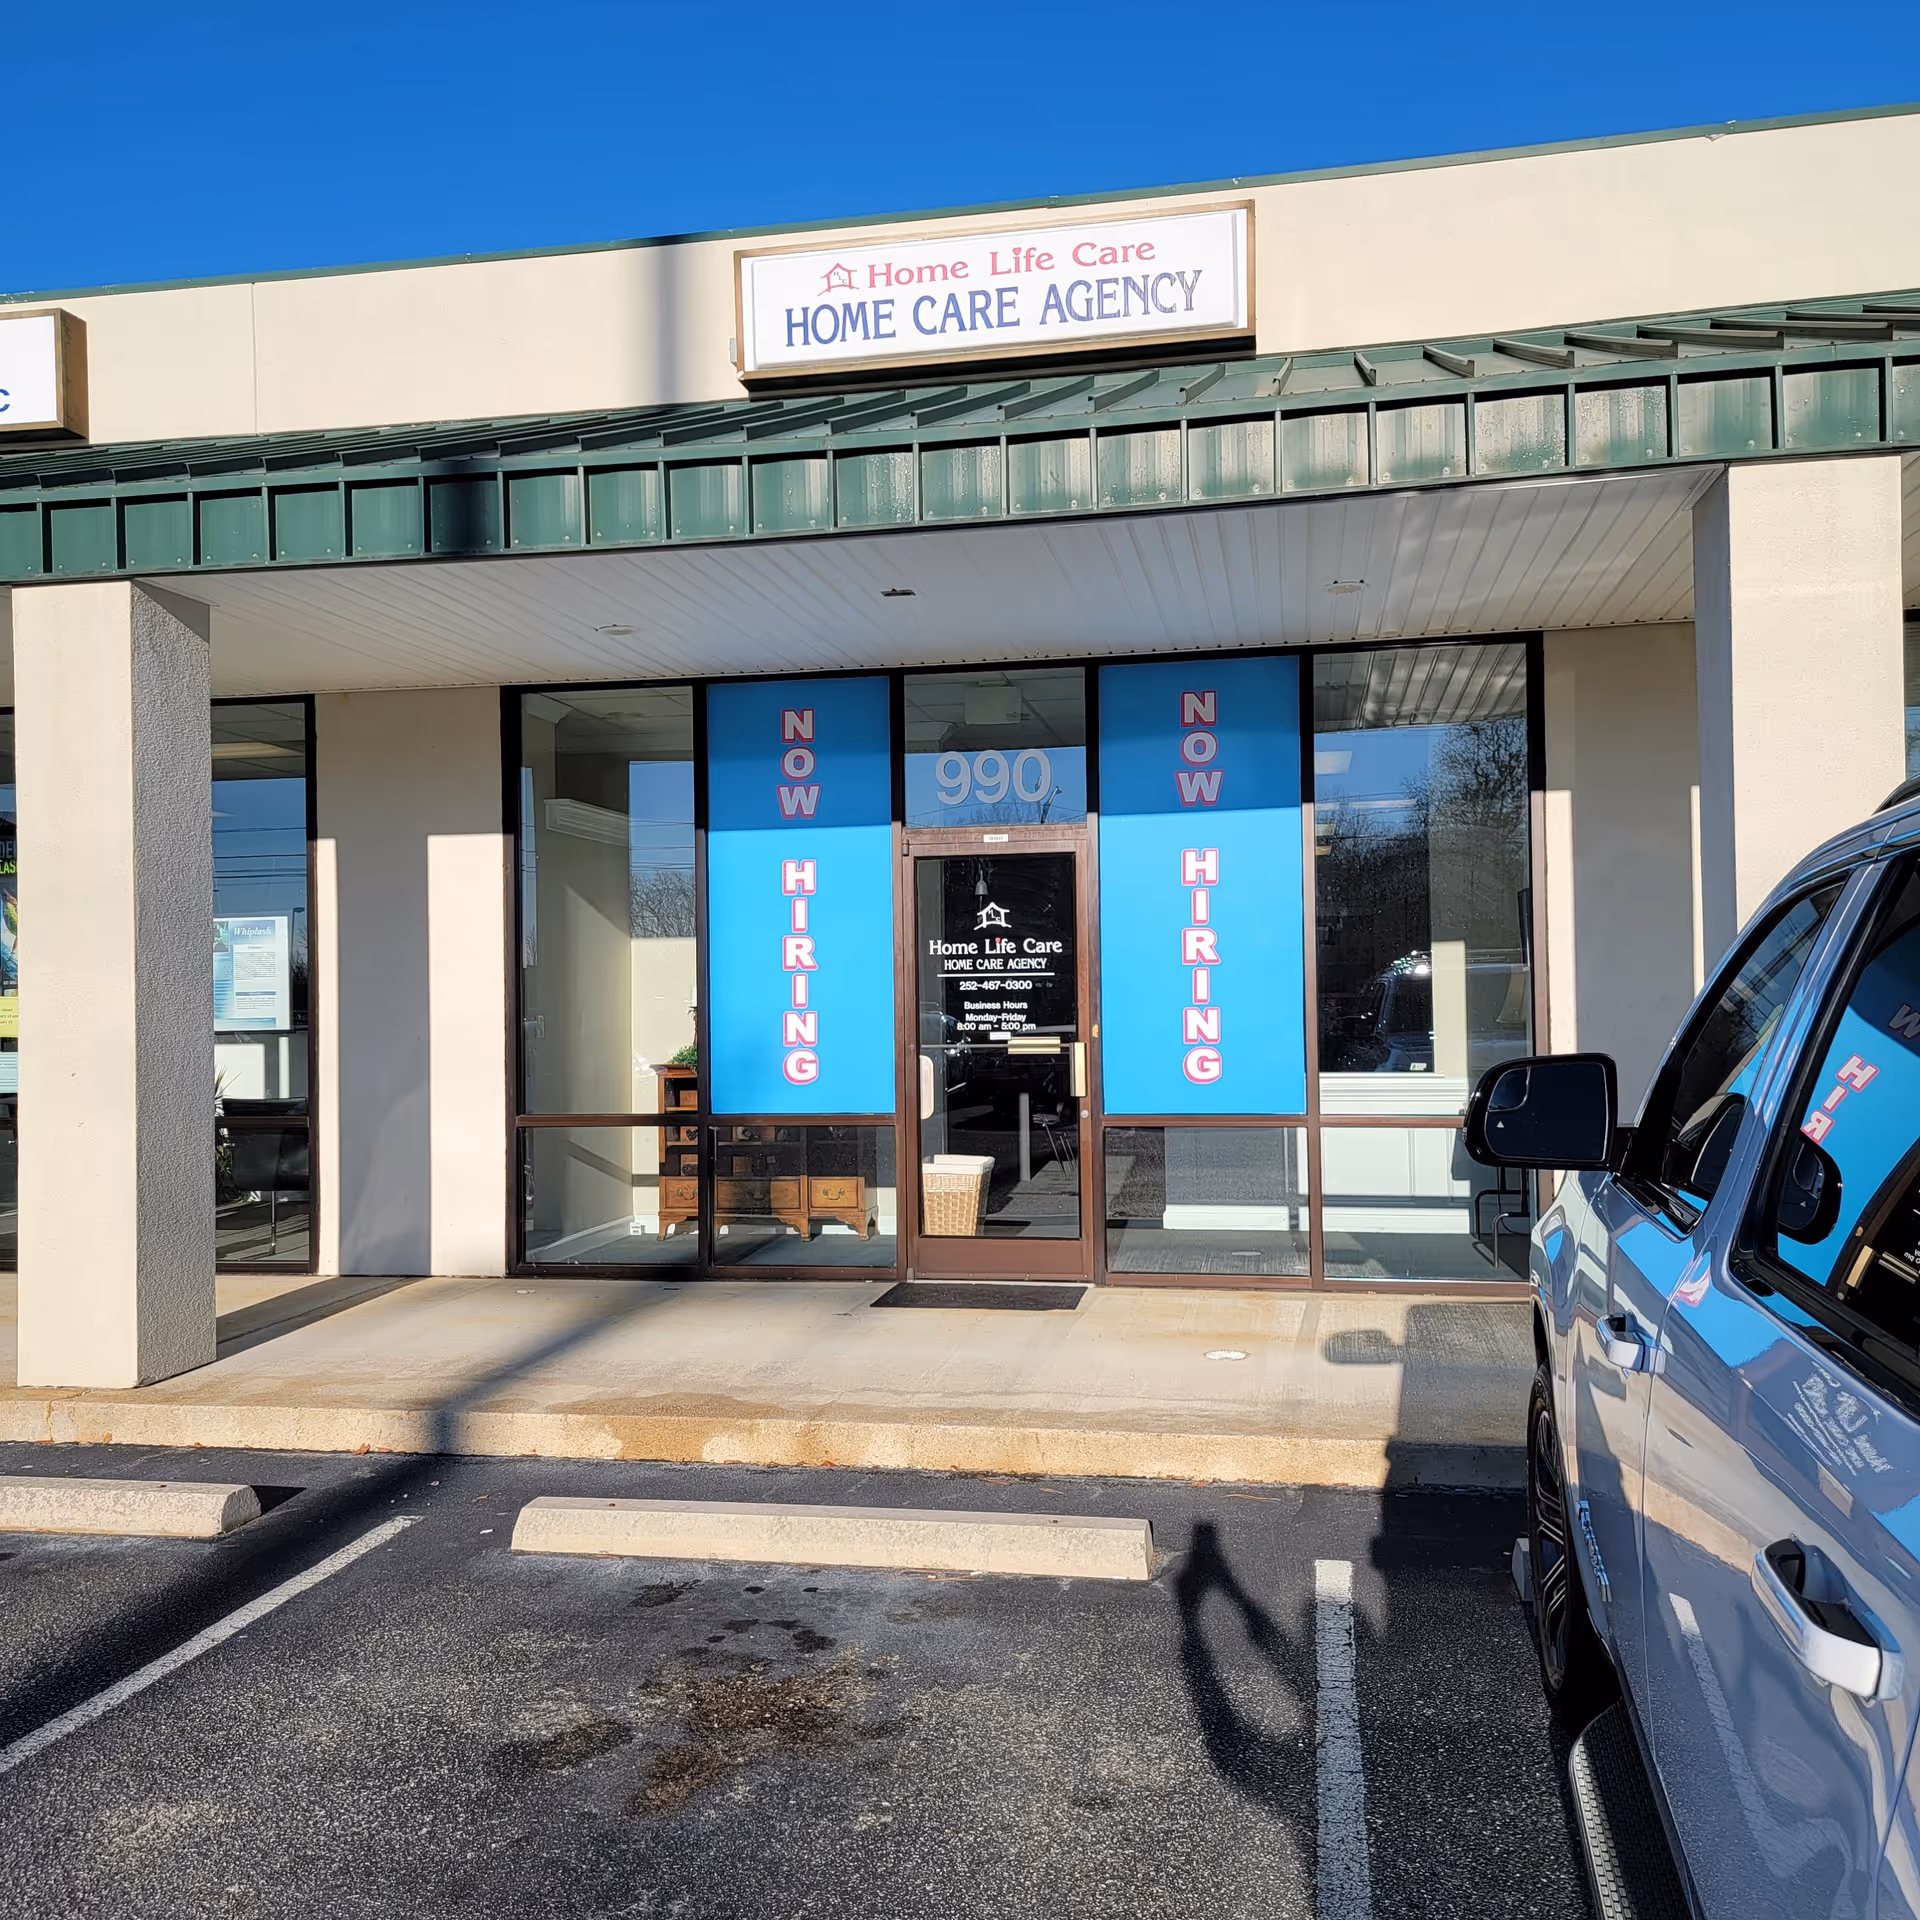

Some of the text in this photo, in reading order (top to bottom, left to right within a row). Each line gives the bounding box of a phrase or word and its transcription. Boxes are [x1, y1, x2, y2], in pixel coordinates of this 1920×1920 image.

[868, 242, 1156, 289] Home Life Care
[785, 269, 1203, 347] HOME CARE AGENCY
[935, 749, 1052, 807] 990
[1175, 689, 1223, 1084] NOW HIRING
[777, 707, 821, 1085] NOW HIRING
[233, 926, 272, 937] Whiplash
[929, 937, 1063, 955] Home Life Care
[944, 958, 1047, 971] HOME CARE AGENCY
[959, 981, 1033, 991] 252-467-0300
[964, 1000, 1028, 1010] Business Hours
[965, 1012, 1027, 1022] Monday-Friday
[957, 1022, 976, 1031] 8:00
[978, 1023, 992, 1031] am
[1001, 1022, 1021, 1031] 5:00
[1022, 1023, 1036, 1032] pm
